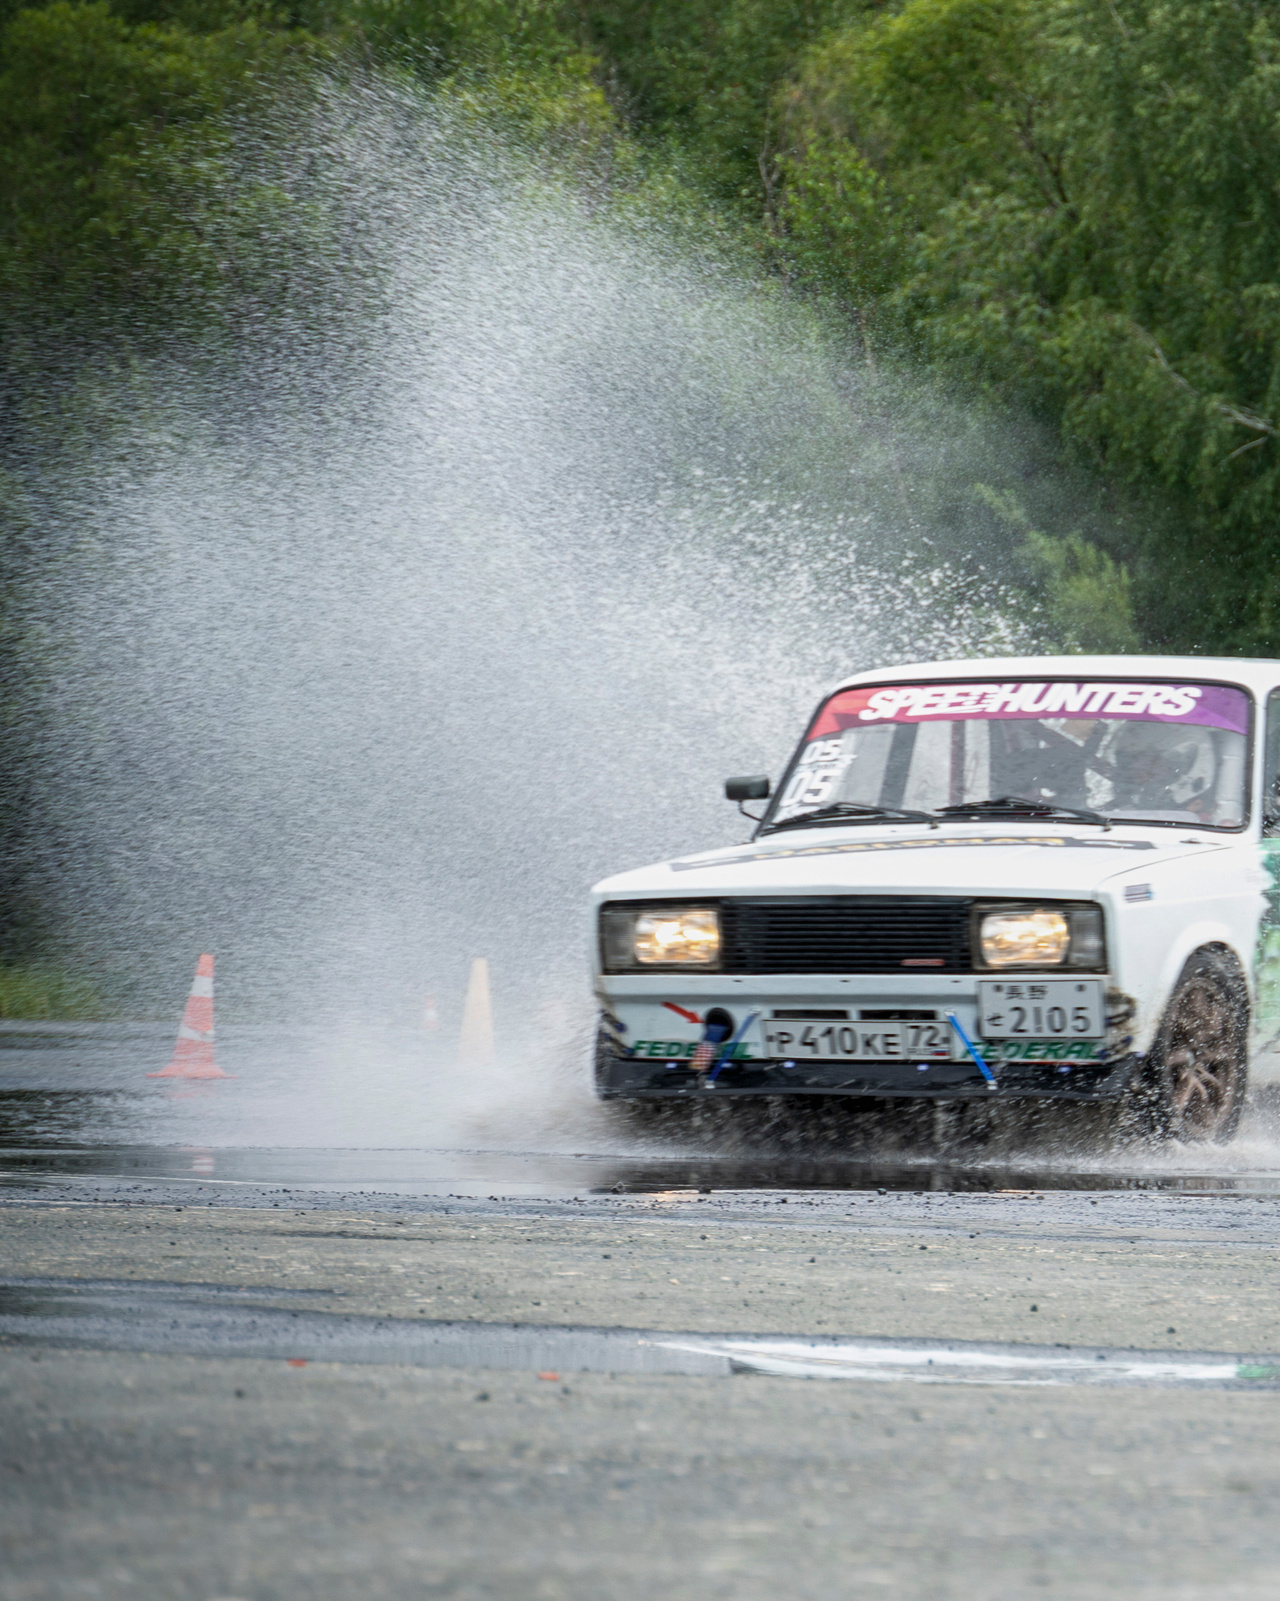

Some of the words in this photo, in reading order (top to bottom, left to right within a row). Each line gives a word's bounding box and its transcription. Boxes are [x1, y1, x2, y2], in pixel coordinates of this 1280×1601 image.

[858, 683, 1202, 720] SPEEDHUNTERS
[780, 769, 843, 807] 05
[1008, 1006, 1092, 1033] 2105
